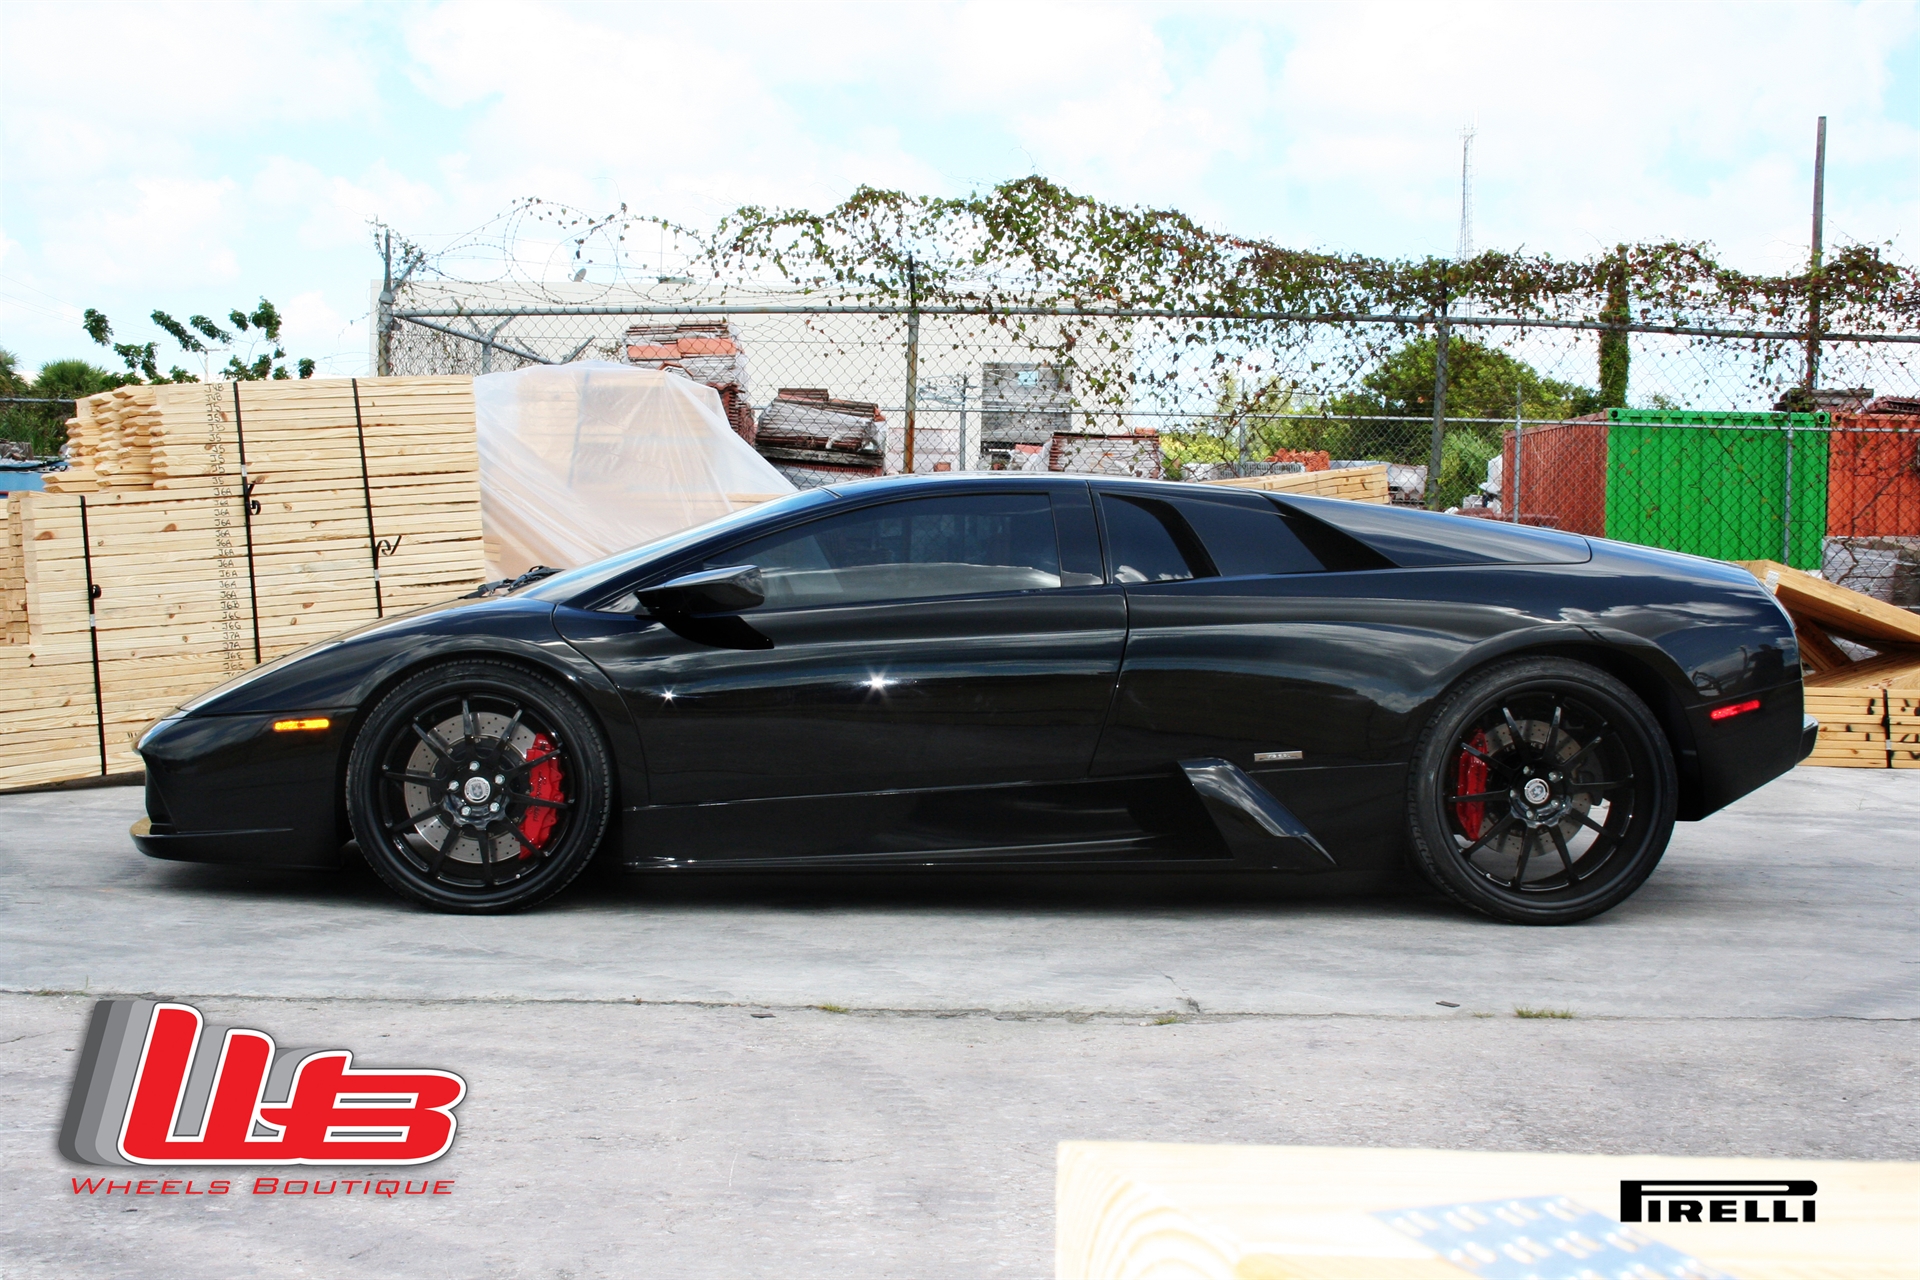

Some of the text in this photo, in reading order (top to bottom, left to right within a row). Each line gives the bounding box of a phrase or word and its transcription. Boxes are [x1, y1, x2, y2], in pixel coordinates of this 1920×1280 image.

[206, 403, 221, 412] J5
[207, 414, 220, 422] J5
[209, 434, 221, 442] J5
[212, 444, 225, 453] J5
[210, 454, 225, 464] J5
[212, 476, 224, 485] J5
[214, 518, 231, 527] J6A
[215, 530, 230, 538] J6A
[216, 539, 232, 547] J6A
[217, 560, 234, 568] J6A
[219, 570, 238, 578] J6A
[219, 580, 237, 588] J6A
[220, 590, 237, 599] J6A
